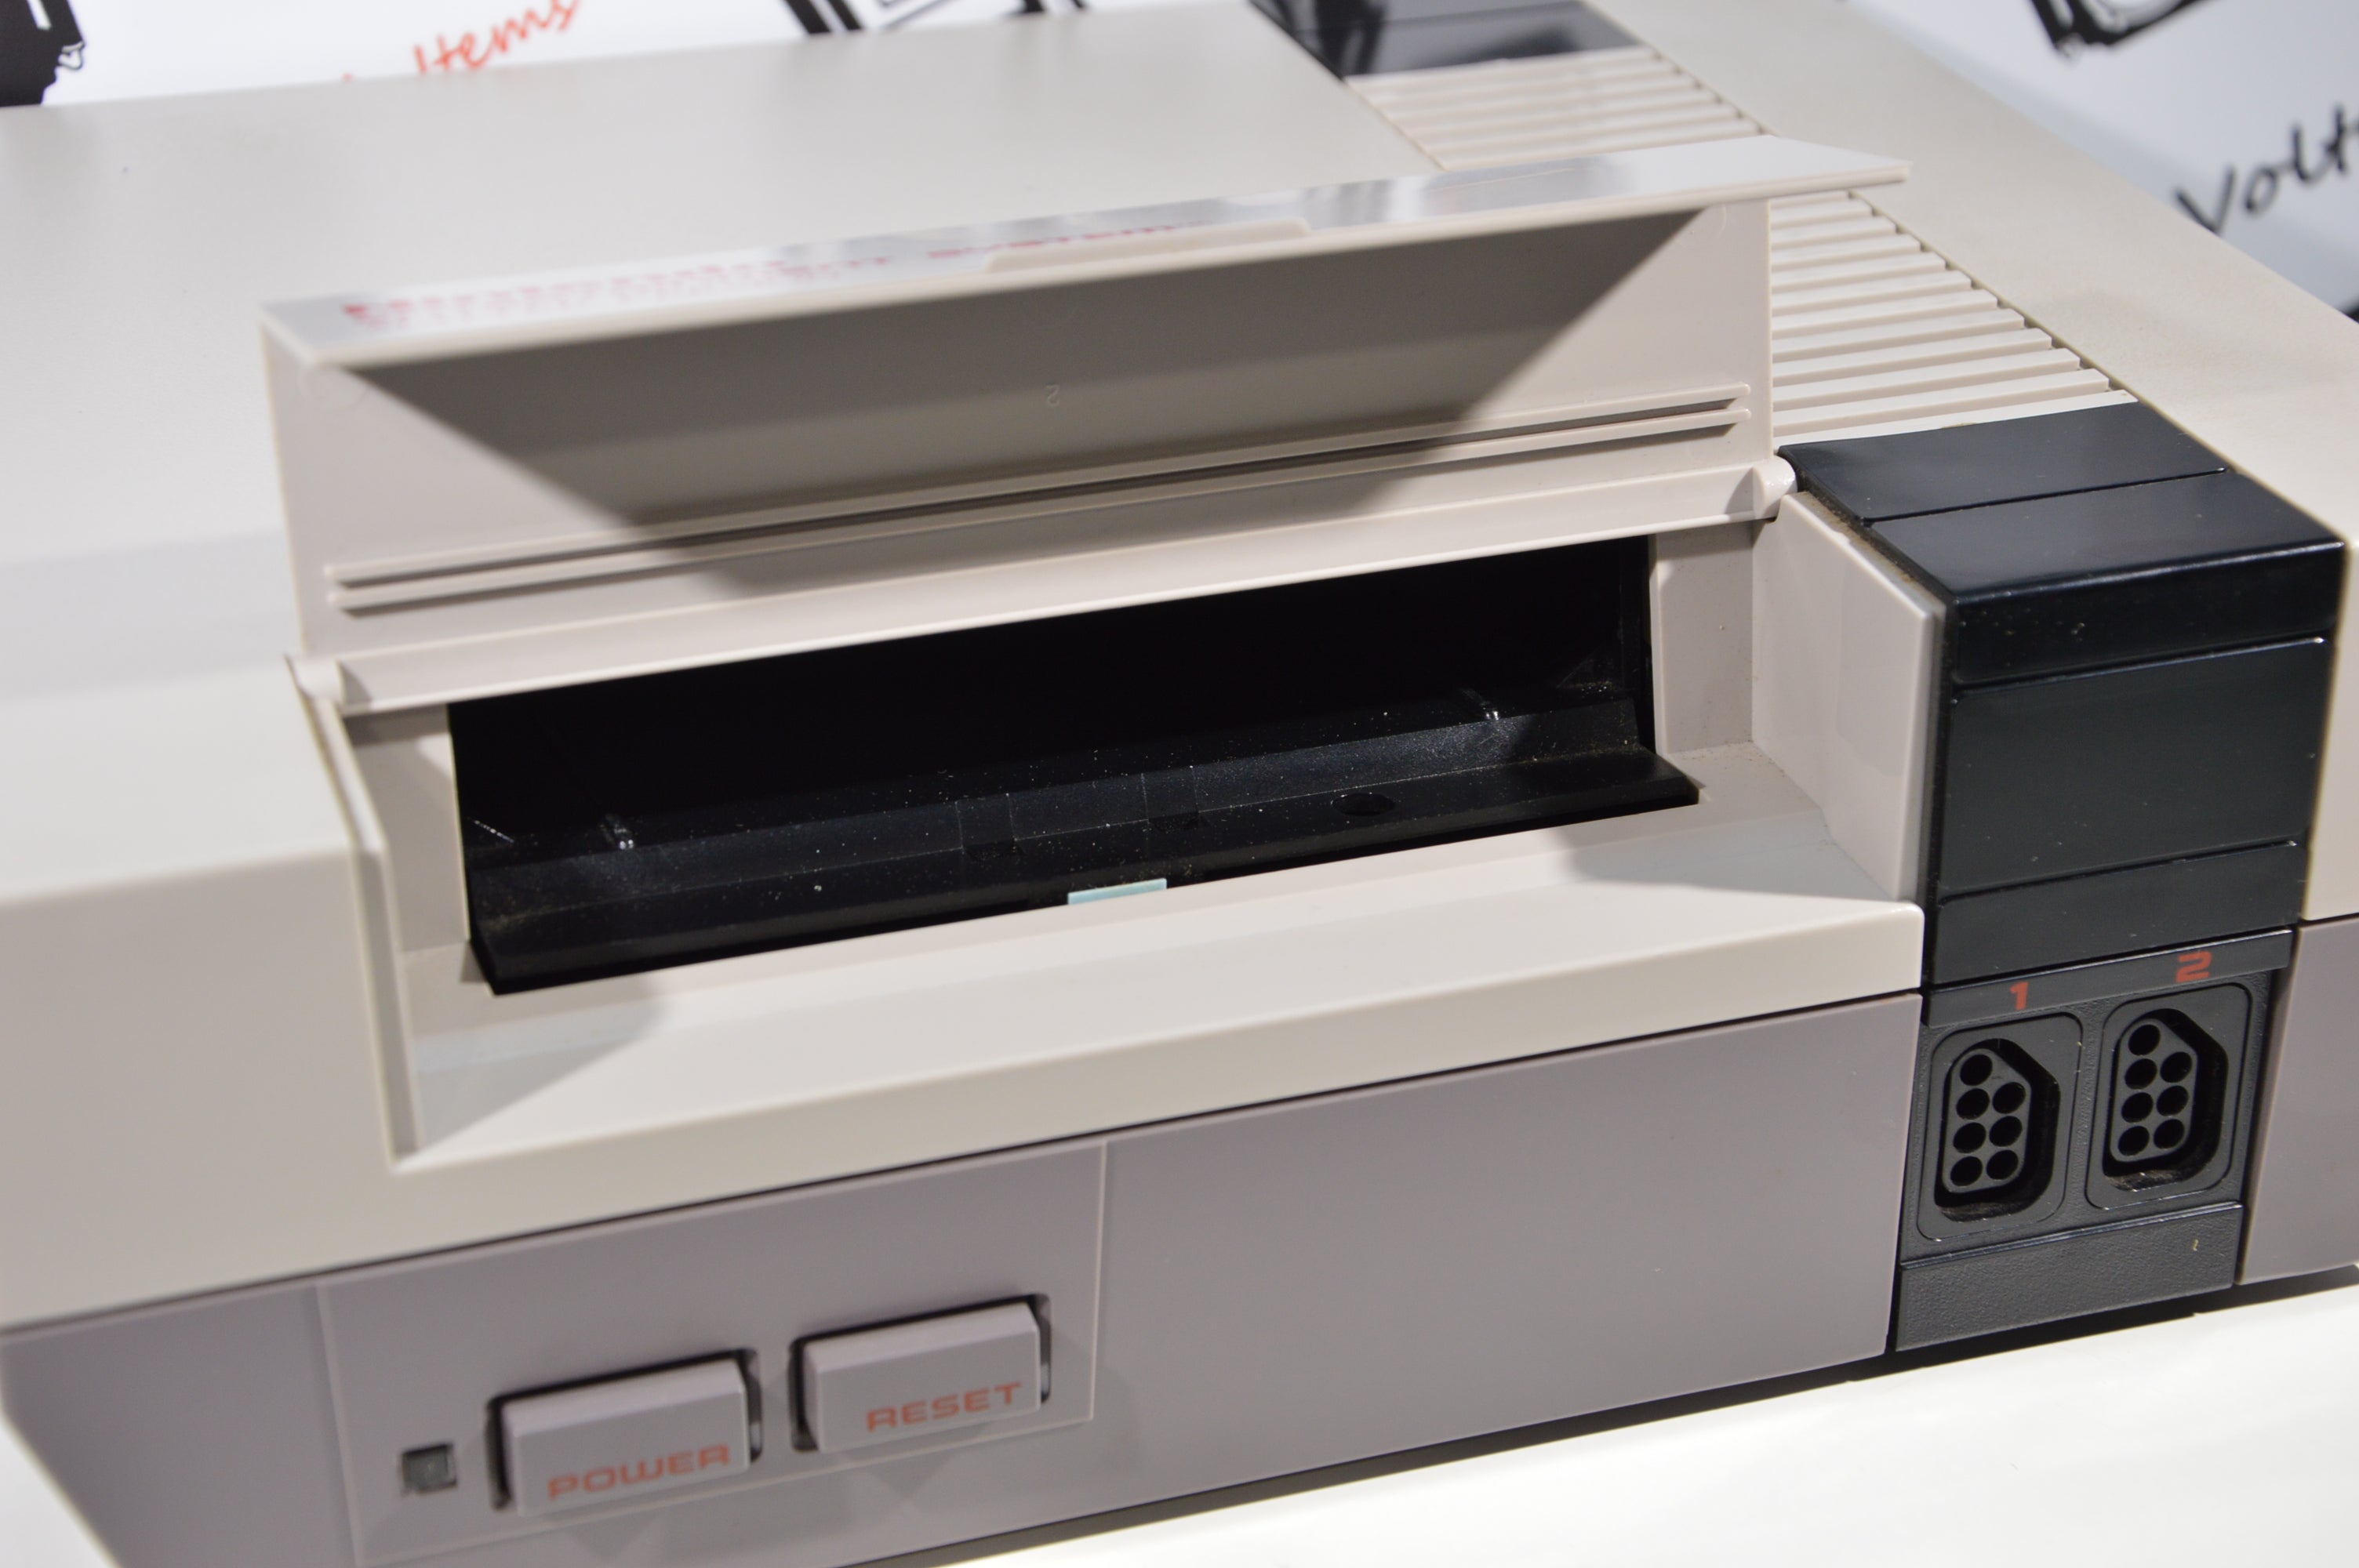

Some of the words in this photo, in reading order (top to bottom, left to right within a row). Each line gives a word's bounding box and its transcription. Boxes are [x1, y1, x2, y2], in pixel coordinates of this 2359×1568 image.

[2175, 103, 2359, 236] Volt
[2010, 981, 2029, 1011] 1
[2175, 951, 2213, 982] 2
[547, 1444, 731, 1501] POWER
[867, 1381, 1023, 1433] RESET
